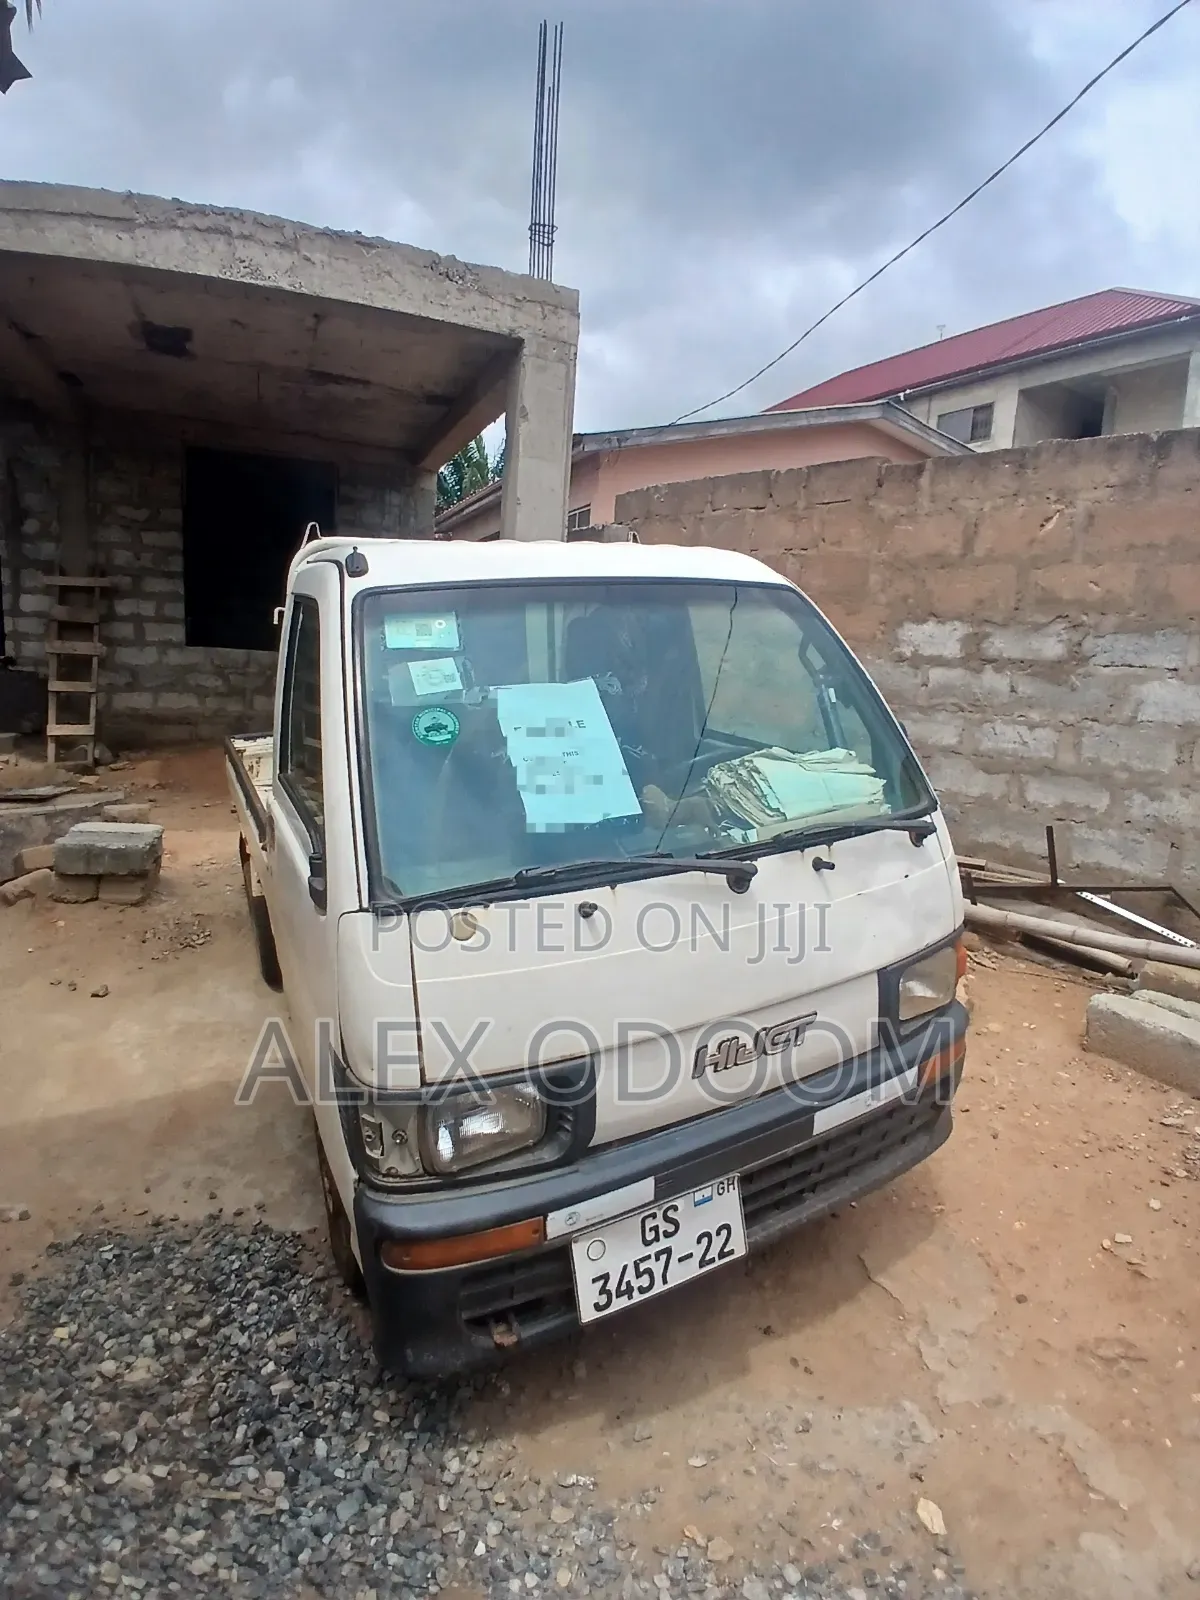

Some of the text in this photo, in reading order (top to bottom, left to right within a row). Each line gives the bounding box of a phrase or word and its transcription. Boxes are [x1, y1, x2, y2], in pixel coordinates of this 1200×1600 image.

[716, 1179, 736, 1197] GH
[640, 1204, 681, 1247] GS
[591, 1223, 735, 1313] 3457-22
